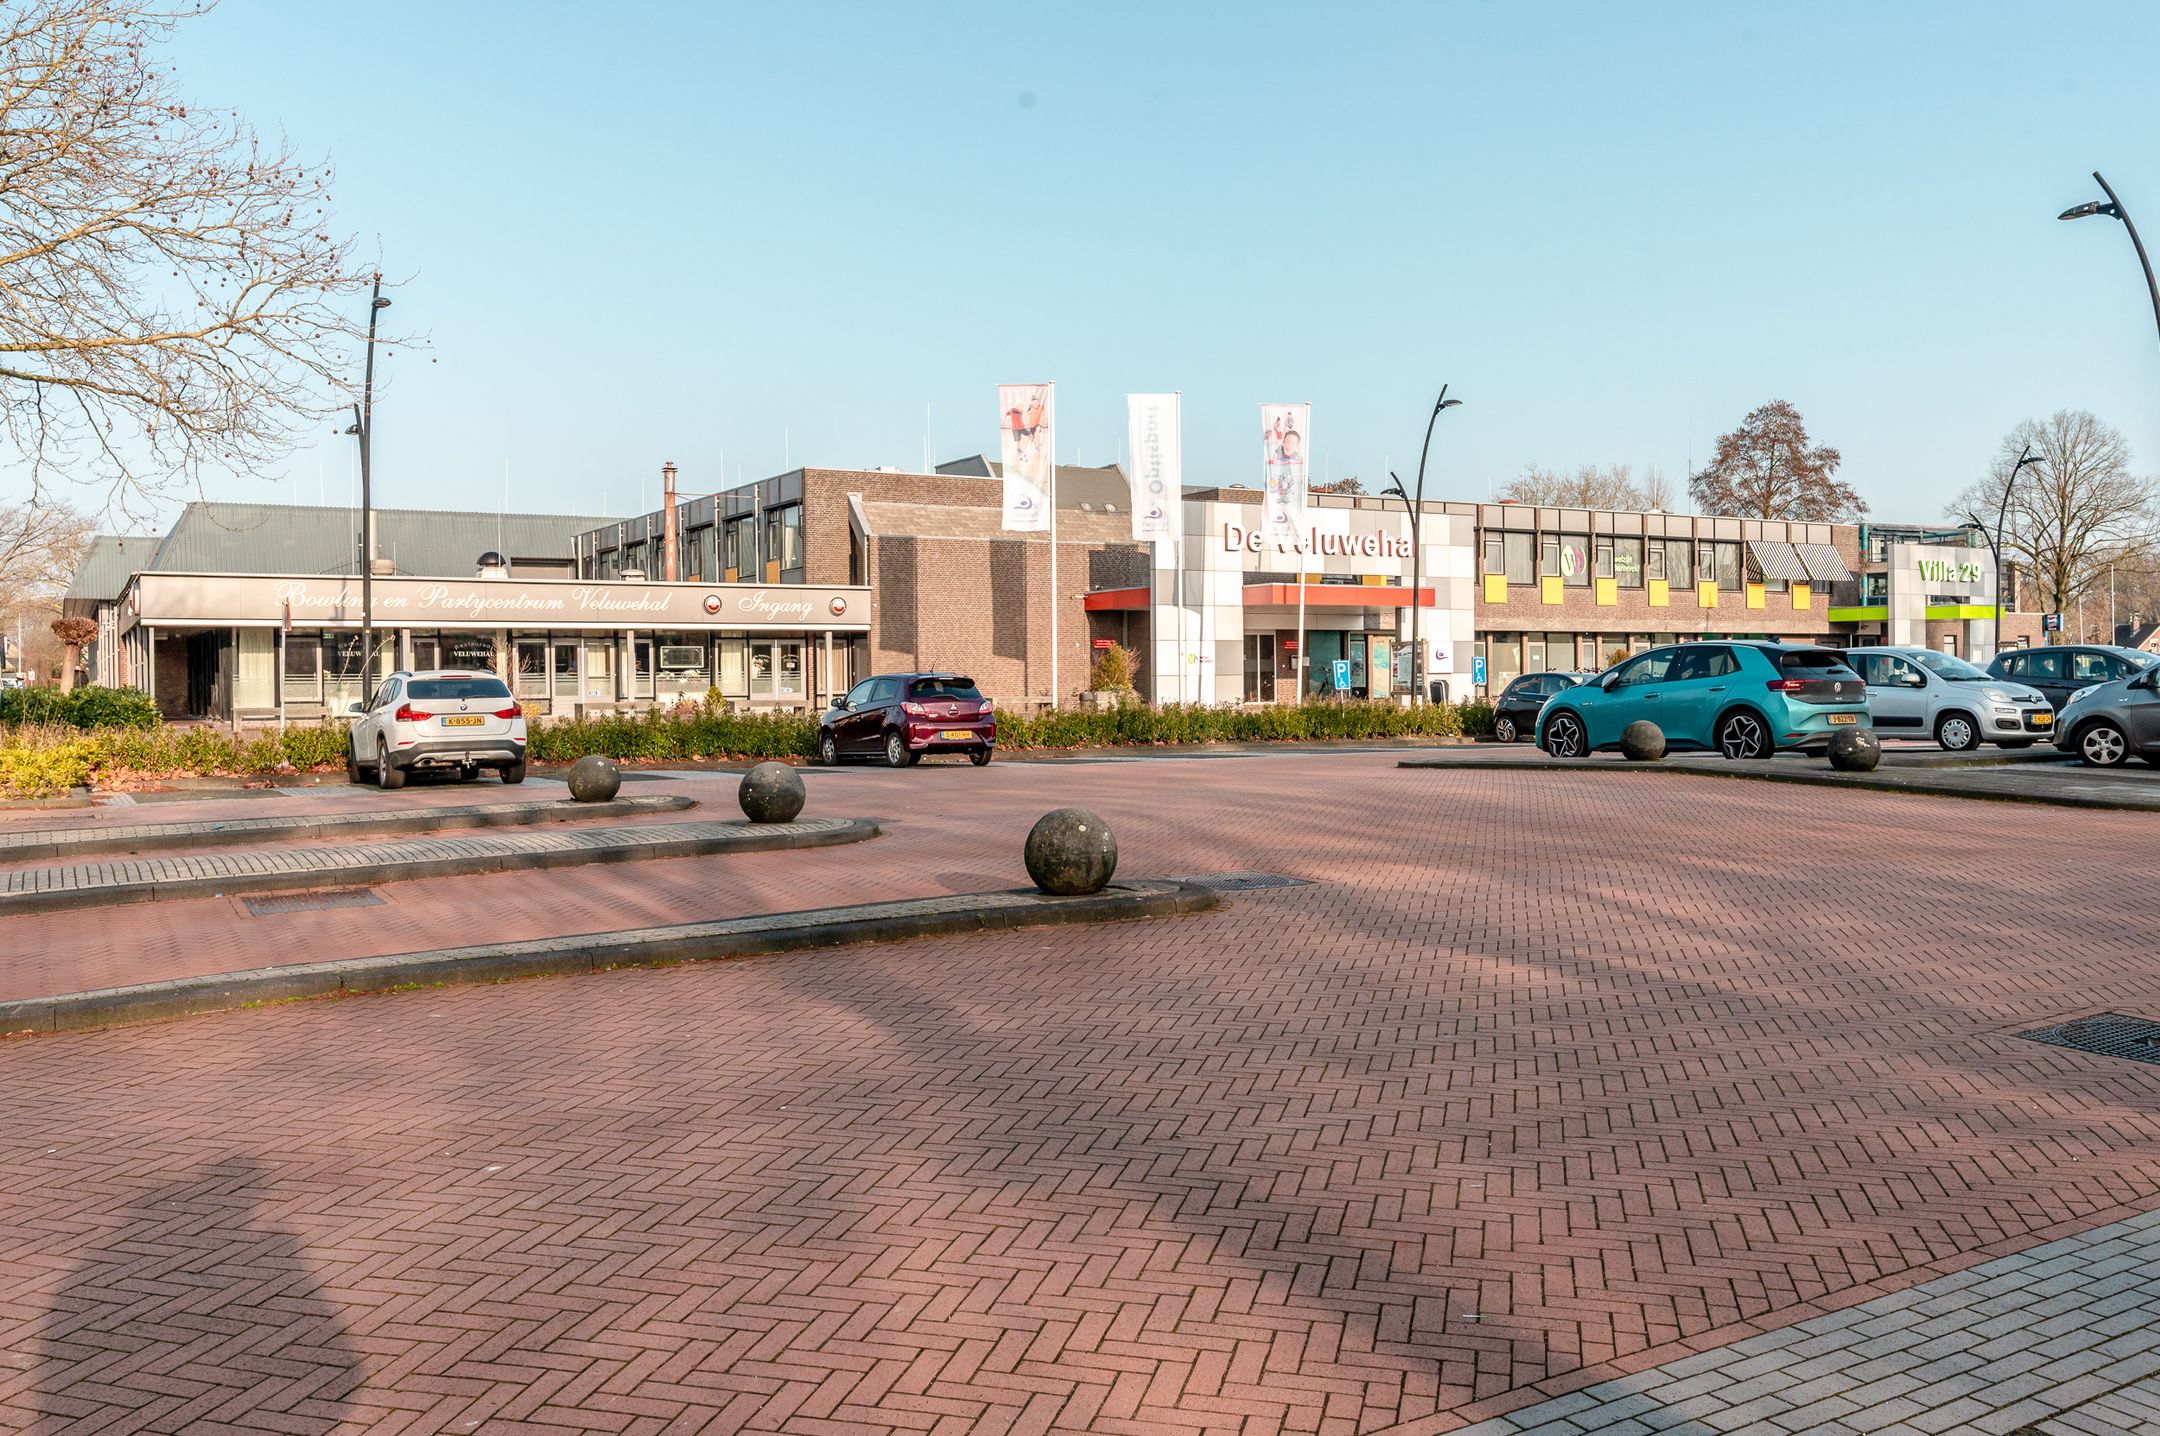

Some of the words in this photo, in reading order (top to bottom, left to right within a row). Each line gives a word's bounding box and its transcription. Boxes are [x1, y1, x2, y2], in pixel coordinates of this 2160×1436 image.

[1224, 523, 1264, 553] De
[1918, 559, 1957, 582] Villa
[384, 595, 409, 609] en
[417, 583, 565, 618] Partycentrum
[572, 586, 673, 612] Veluwehal
[738, 590, 815, 621] Ingang
[448, 717, 482, 725] K-855-JN
